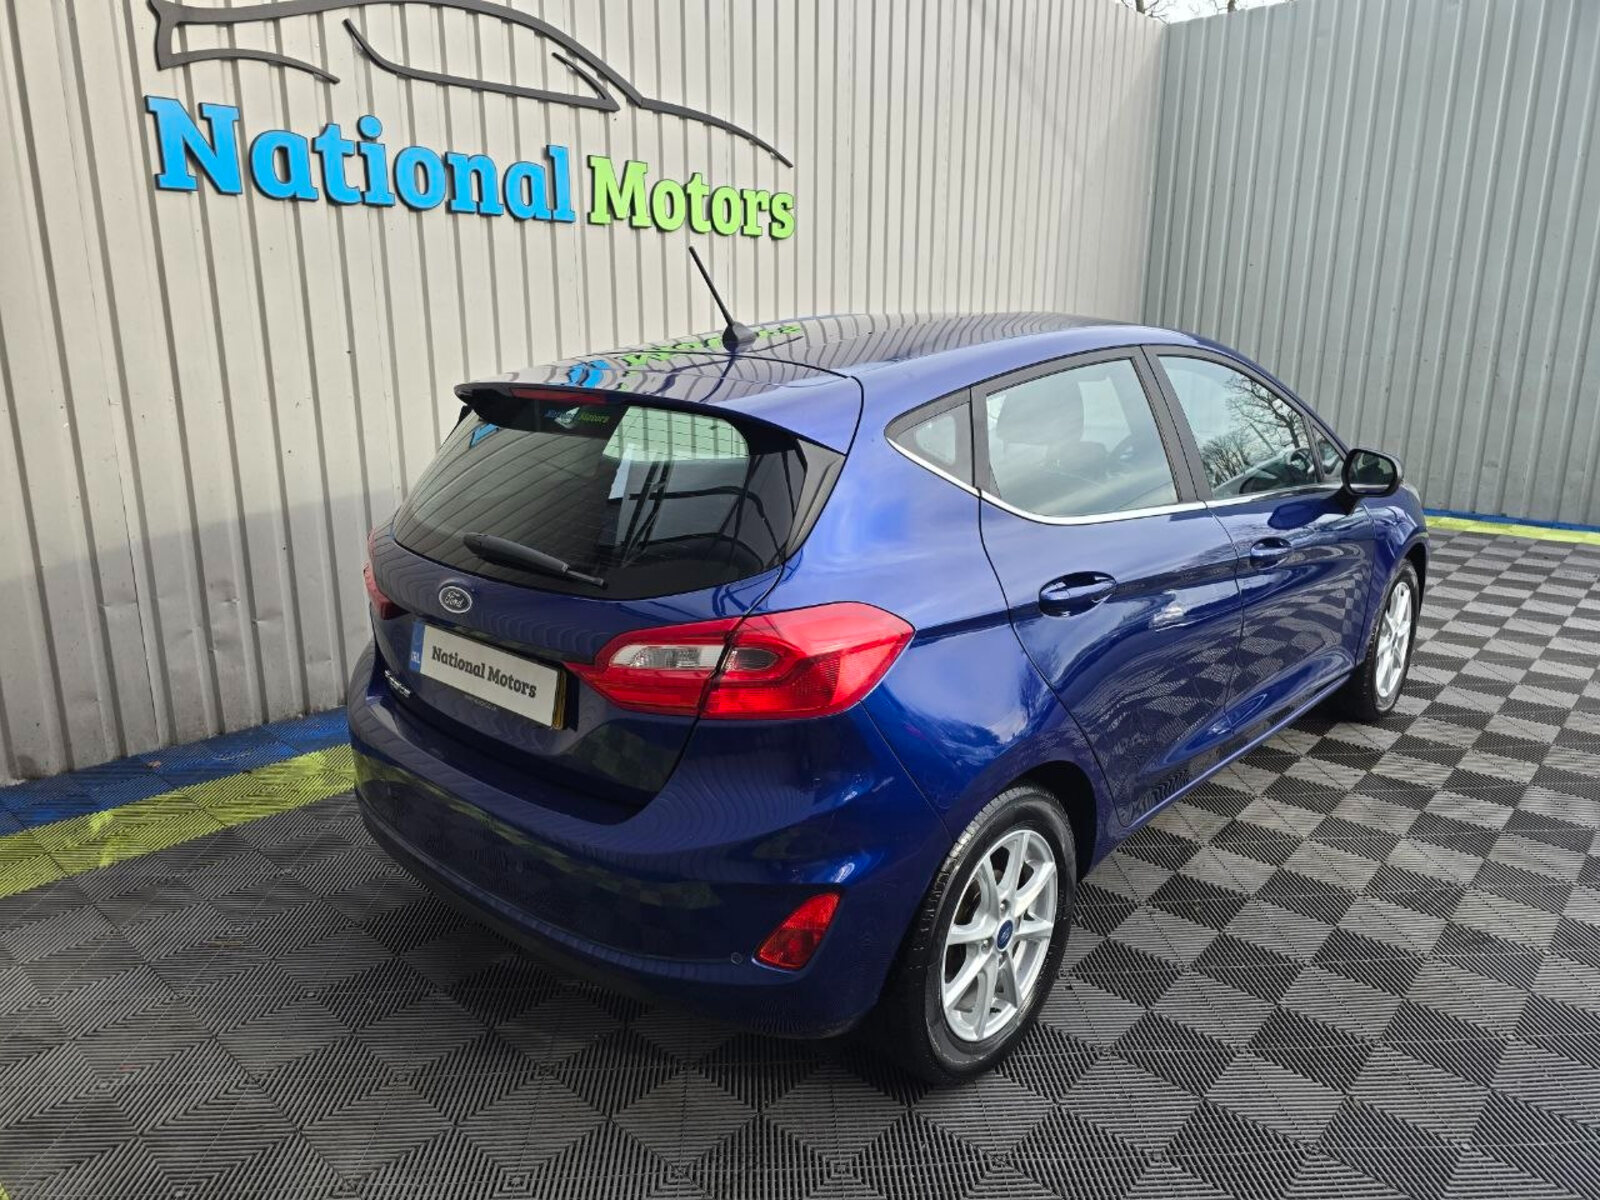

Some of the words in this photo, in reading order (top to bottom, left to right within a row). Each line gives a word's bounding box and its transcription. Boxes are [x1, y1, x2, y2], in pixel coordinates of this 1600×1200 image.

[146, 95, 575, 222] National
[587, 155, 796, 240] Motors
[432, 645, 485, 681] National
[487, 661, 537, 698] Motors
